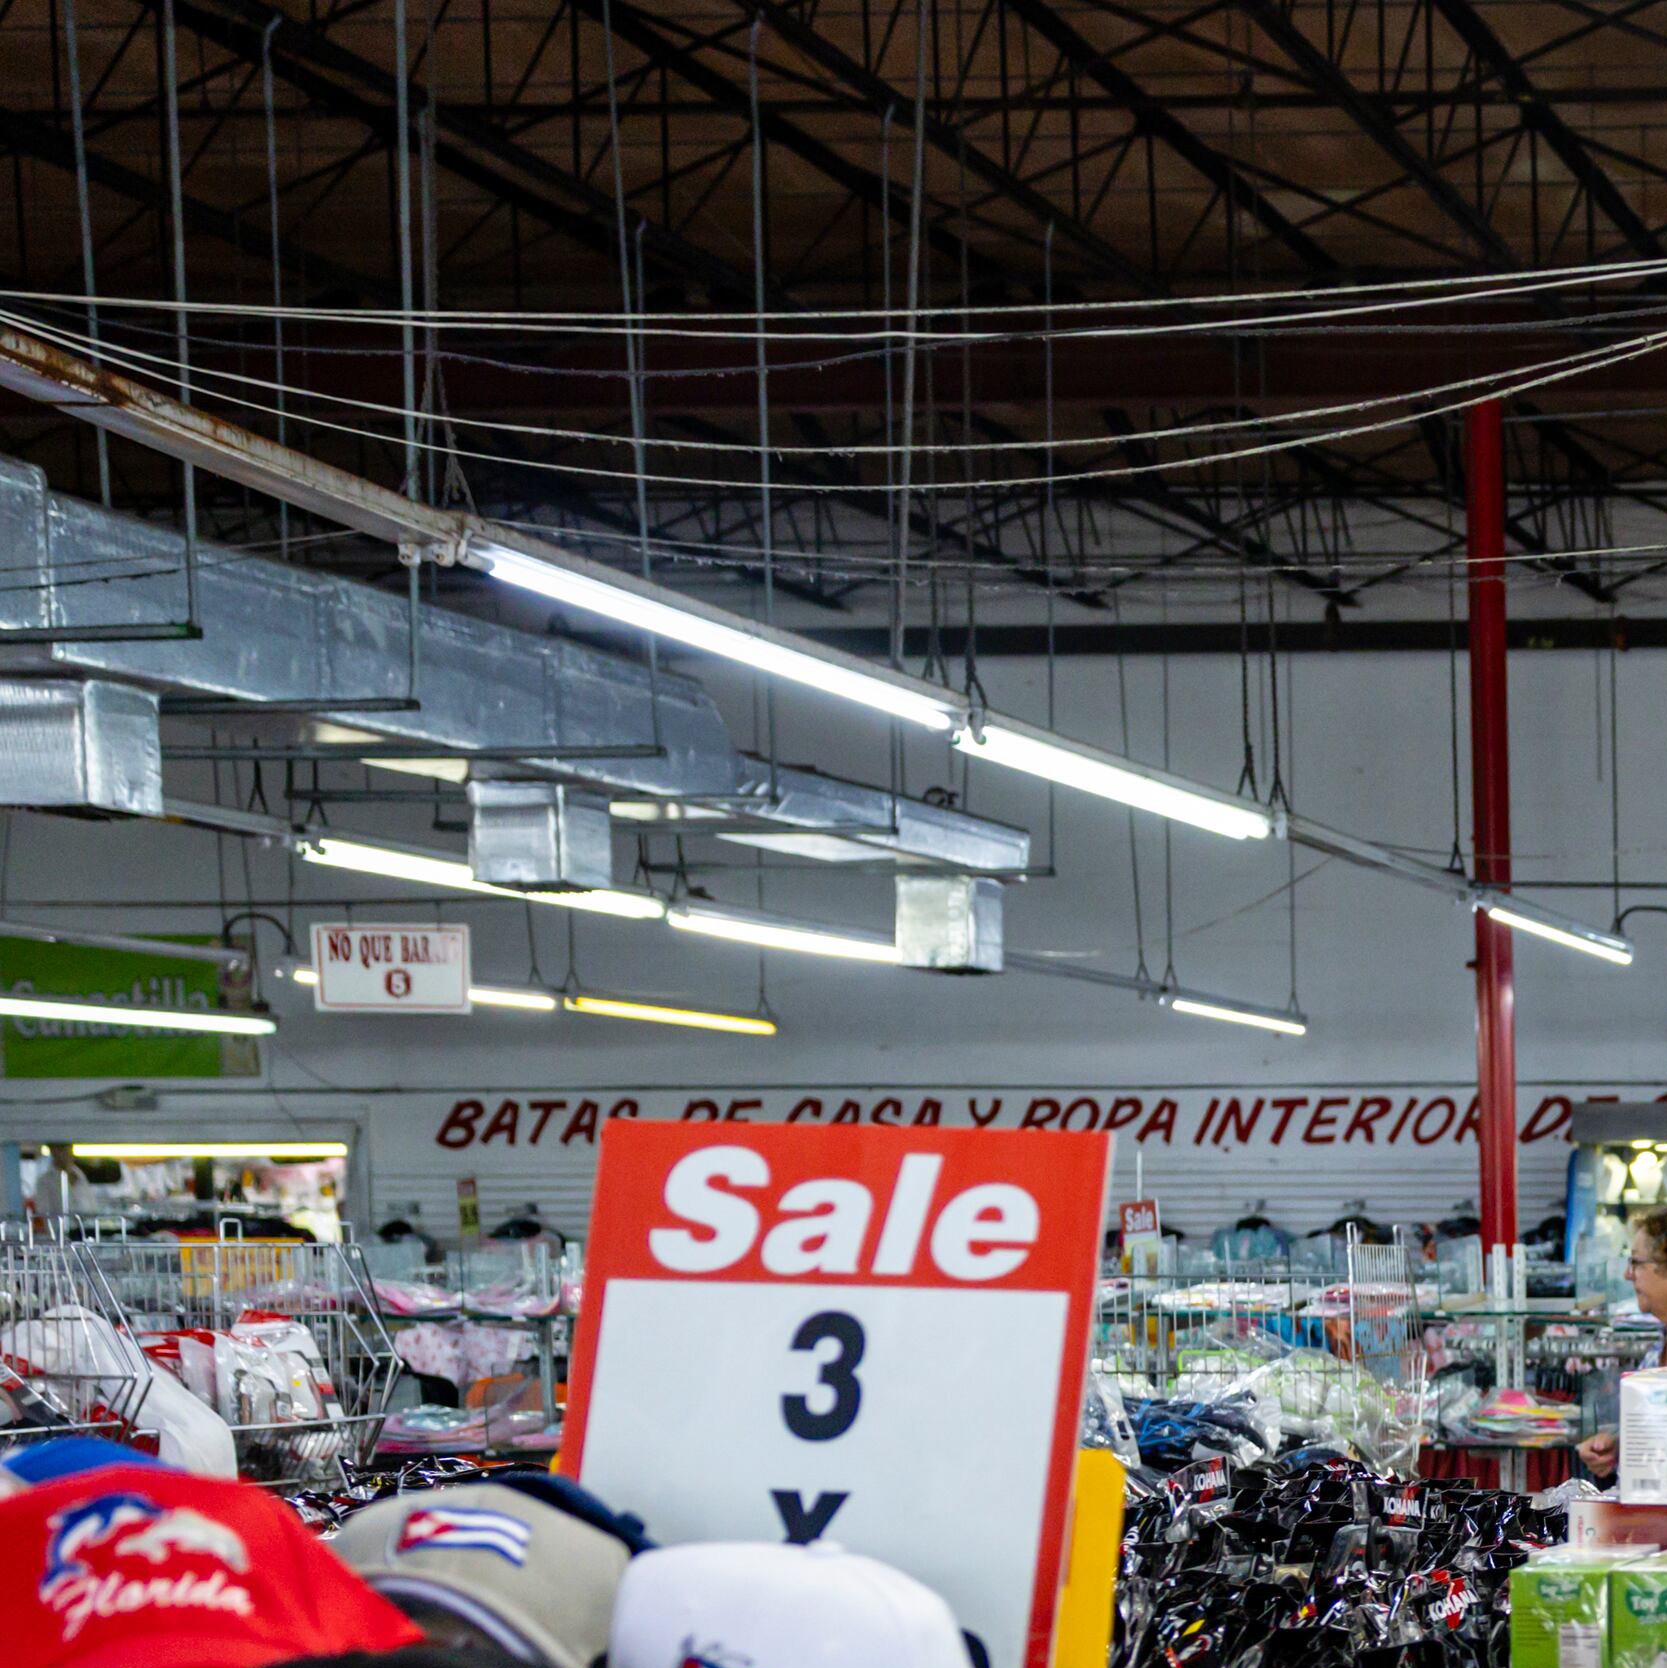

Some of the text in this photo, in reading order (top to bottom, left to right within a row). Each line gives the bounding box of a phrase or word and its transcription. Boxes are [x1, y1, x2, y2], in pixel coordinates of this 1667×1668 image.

[328, 933, 352, 963] NO
[359, 934, 393, 966] QUE
[1022, 1096, 1178, 1146] ROPA
[1193, 1096, 1483, 1149] INTERIOR
[648, 1143, 1041, 1283] Sale
[1123, 1205, 1156, 1234] Sale
[779, 1310, 868, 1442] 3
[1193, 1467, 1228, 1492] KOHANA
[1382, 1496, 1422, 1518] KOHANA
[40, 1567, 256, 1643] Florida
[1428, 1588, 1480, 1622] KOHANA
[1630, 1594, 1659, 1614] Top
